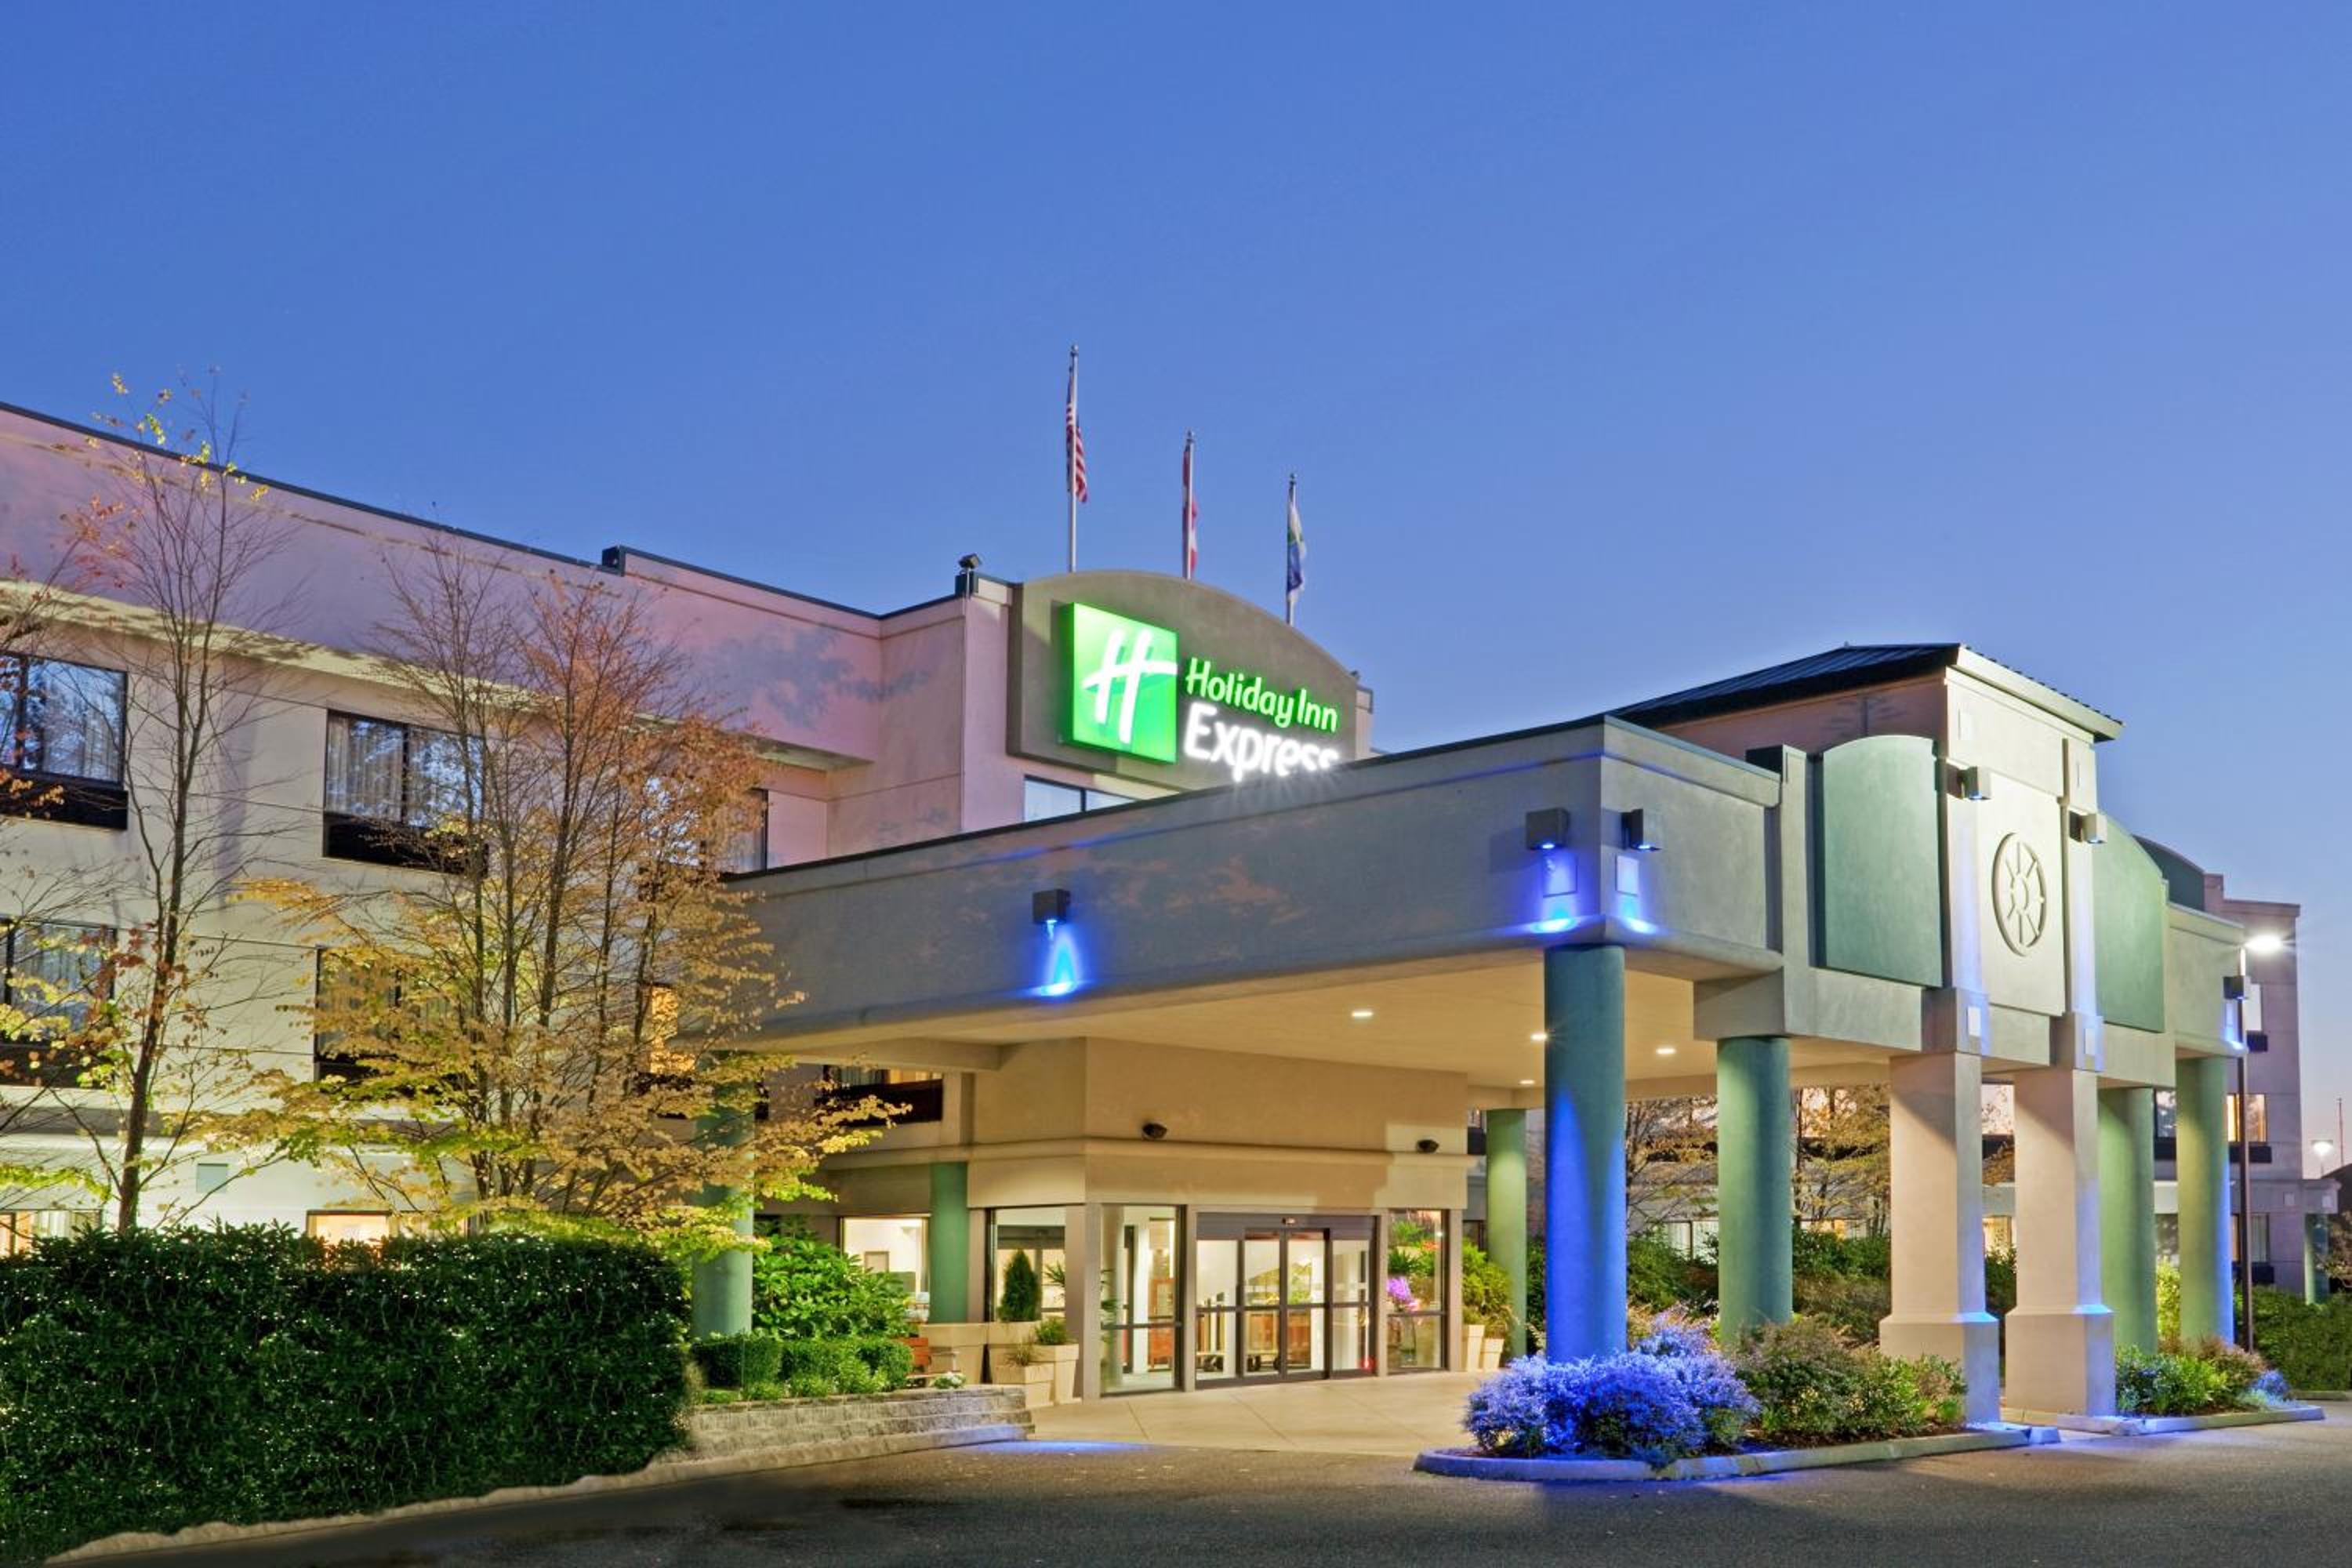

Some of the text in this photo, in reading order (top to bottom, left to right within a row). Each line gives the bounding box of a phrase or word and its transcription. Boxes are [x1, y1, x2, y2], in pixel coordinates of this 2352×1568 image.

[1082, 630, 1178, 744] H
[1185, 657, 1338, 732] Holiday Inn
